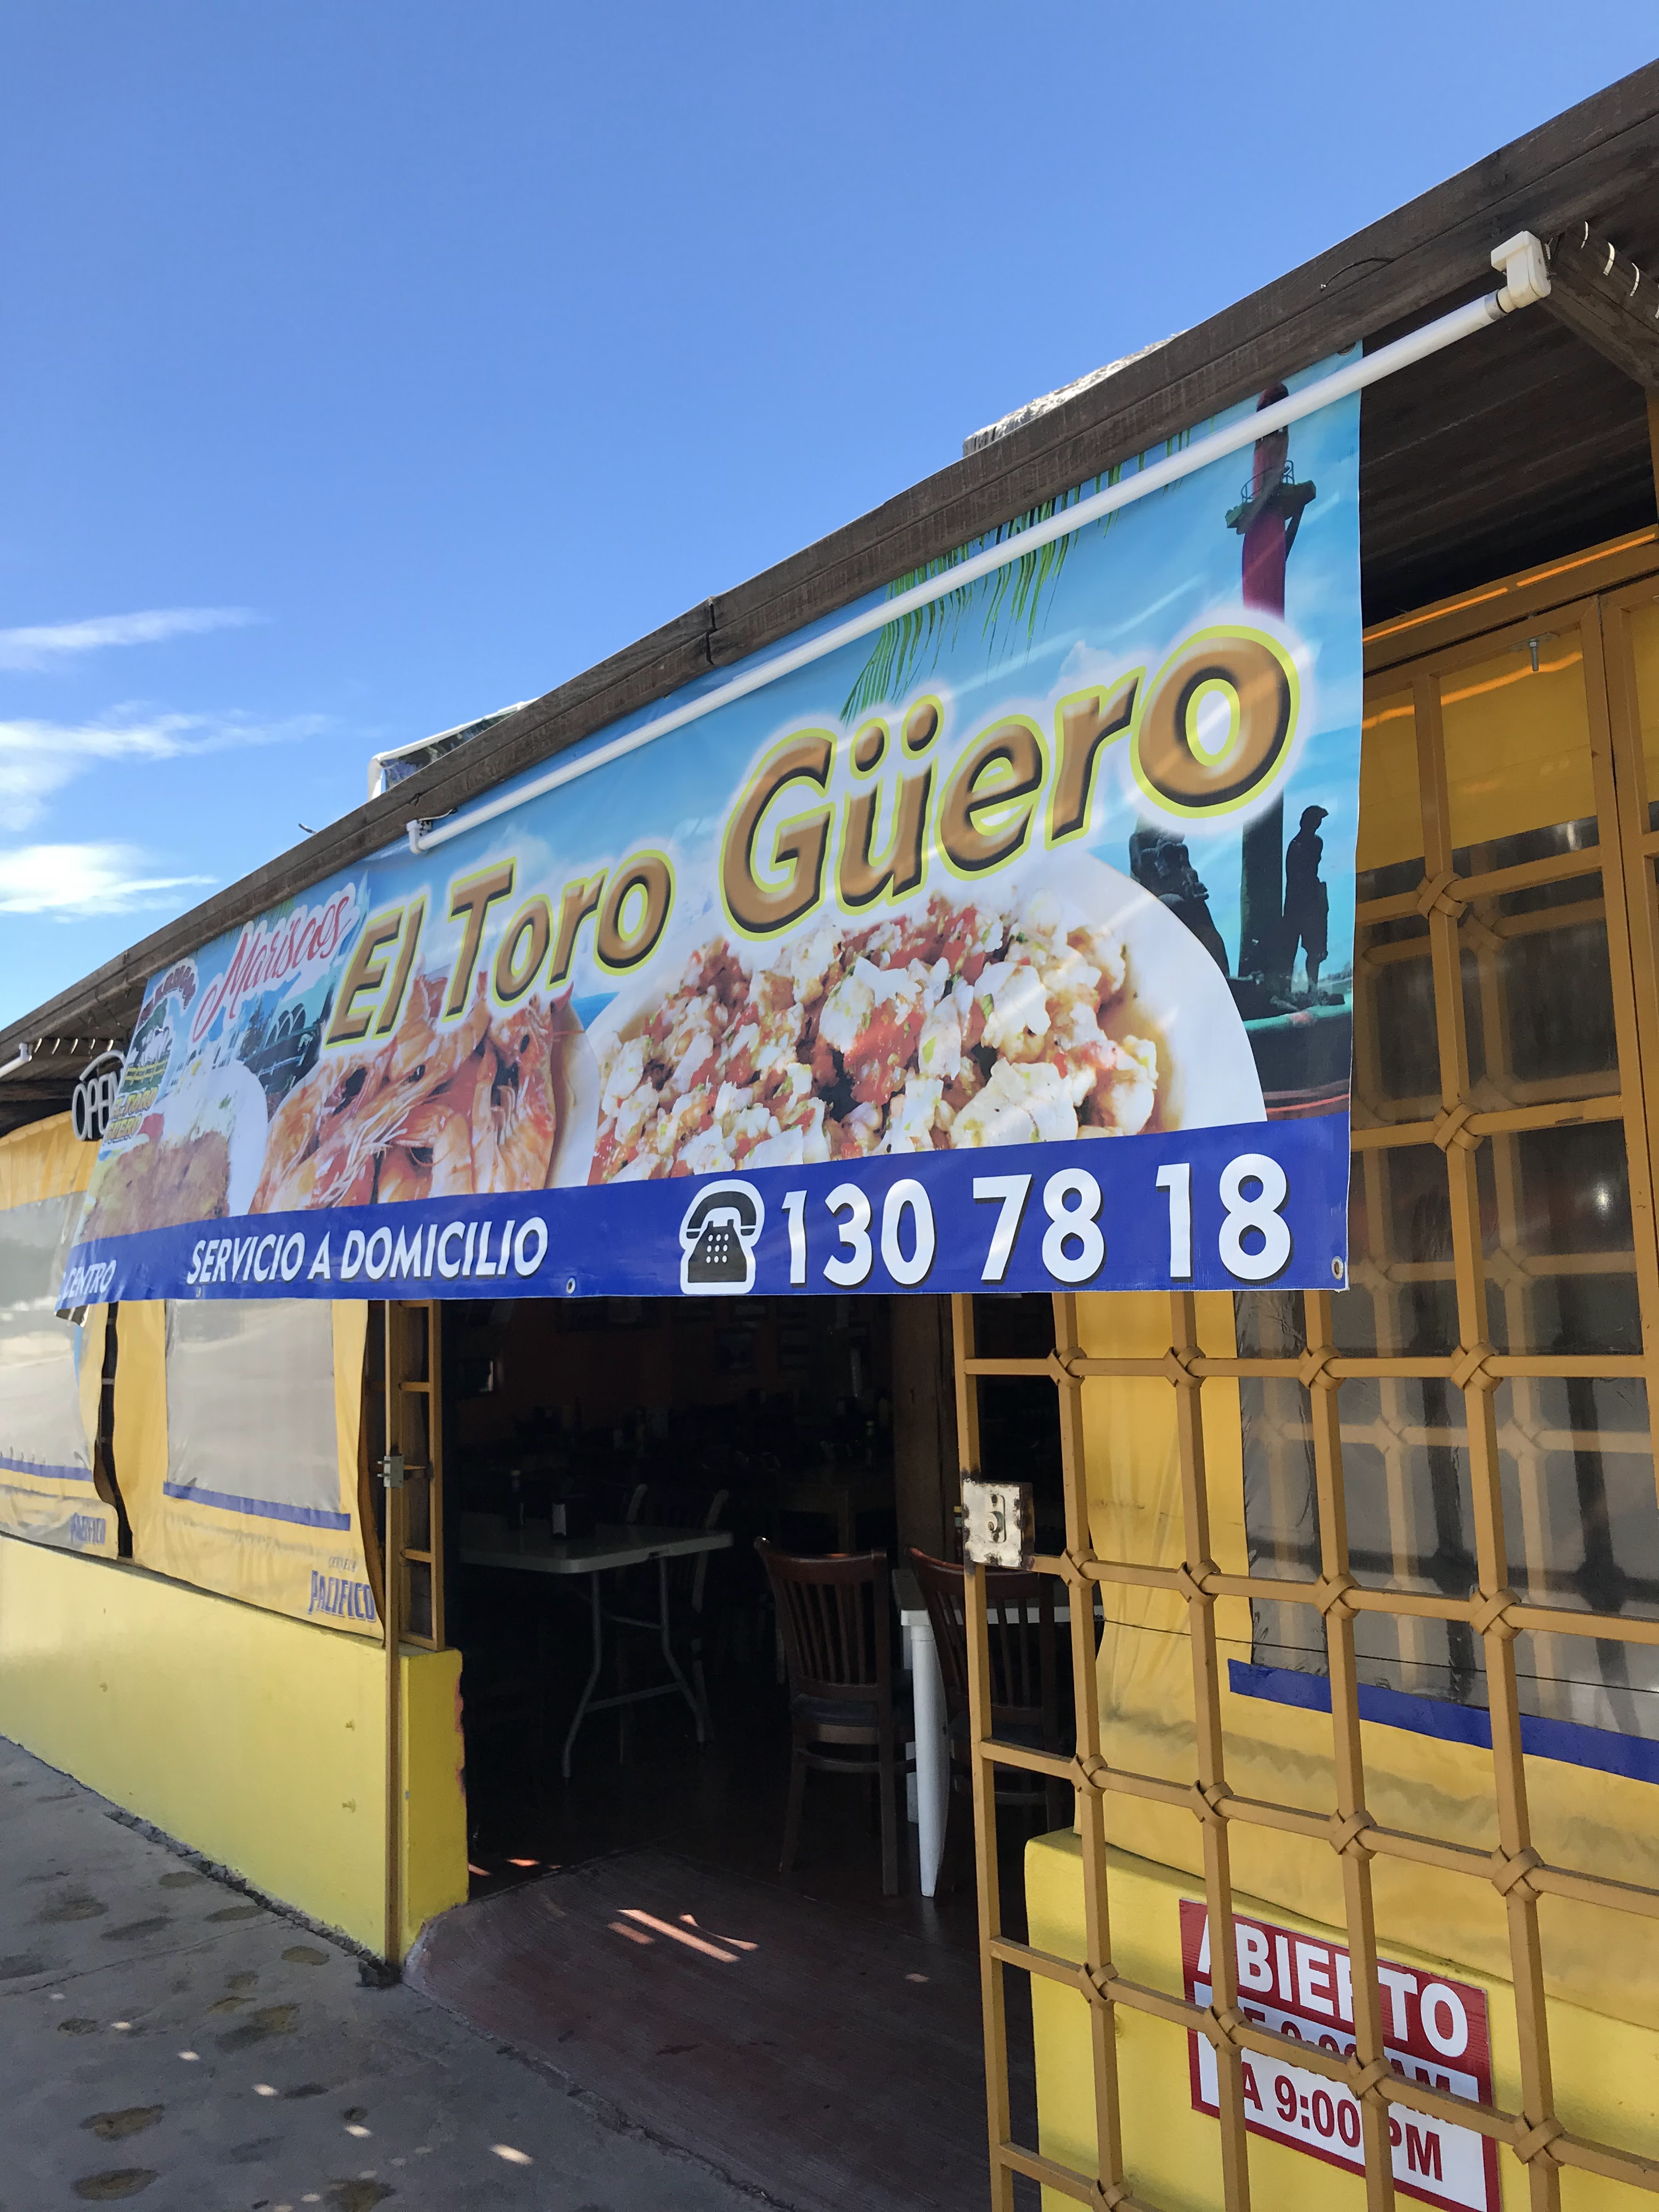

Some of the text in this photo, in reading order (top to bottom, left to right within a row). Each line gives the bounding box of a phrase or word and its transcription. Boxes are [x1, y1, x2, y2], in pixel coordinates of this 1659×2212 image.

[325, 625, 1300, 1051] El Toro Güero
[192, 896, 351, 1043] Mariscos
[187, 1216, 549, 1285] SERVICIO A DOMICILIO
[780, 1152, 1291, 1287] 130 78 18
[63, 1259, 117, 1300] CENTRO
[307, 1570, 377, 1623] PACIFICO
[1198, 1915, 1468, 2057] BIETO
[1274, 2075, 1361, 2148] 9:00
